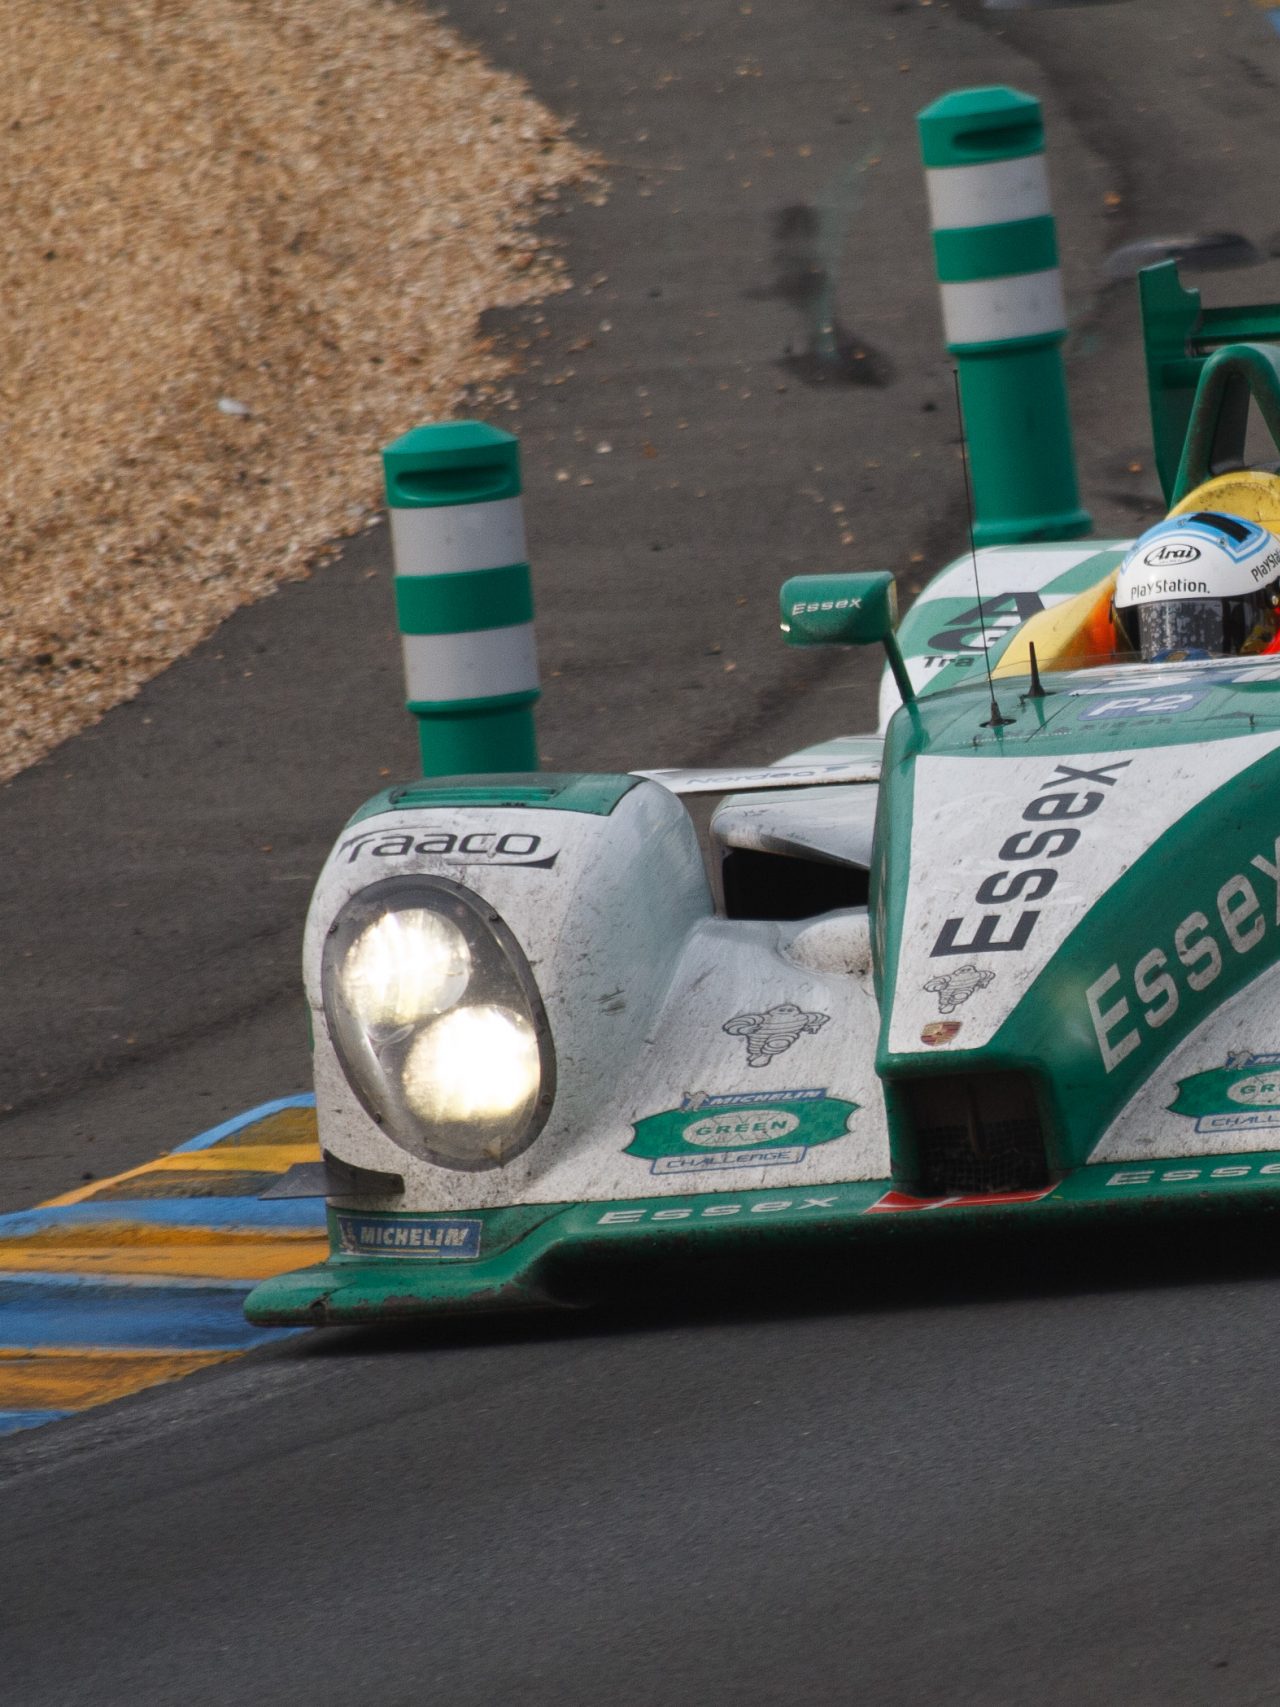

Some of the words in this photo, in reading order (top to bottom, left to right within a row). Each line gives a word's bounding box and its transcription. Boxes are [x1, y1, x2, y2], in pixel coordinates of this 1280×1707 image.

[1155, 546, 1193, 560] Arai
[791, 597, 862, 616] Essex
[1087, 694, 1193, 717] P2
[929, 758, 1134, 958] Essex
[710, 1090, 822, 1106] MICHELIN
[695, 1120, 788, 1136] GREEN
[666, 1151, 791, 1169] CHALLENGE
[596, 1196, 840, 1226] Essex
[359, 1220, 469, 1249] MICHELIN
